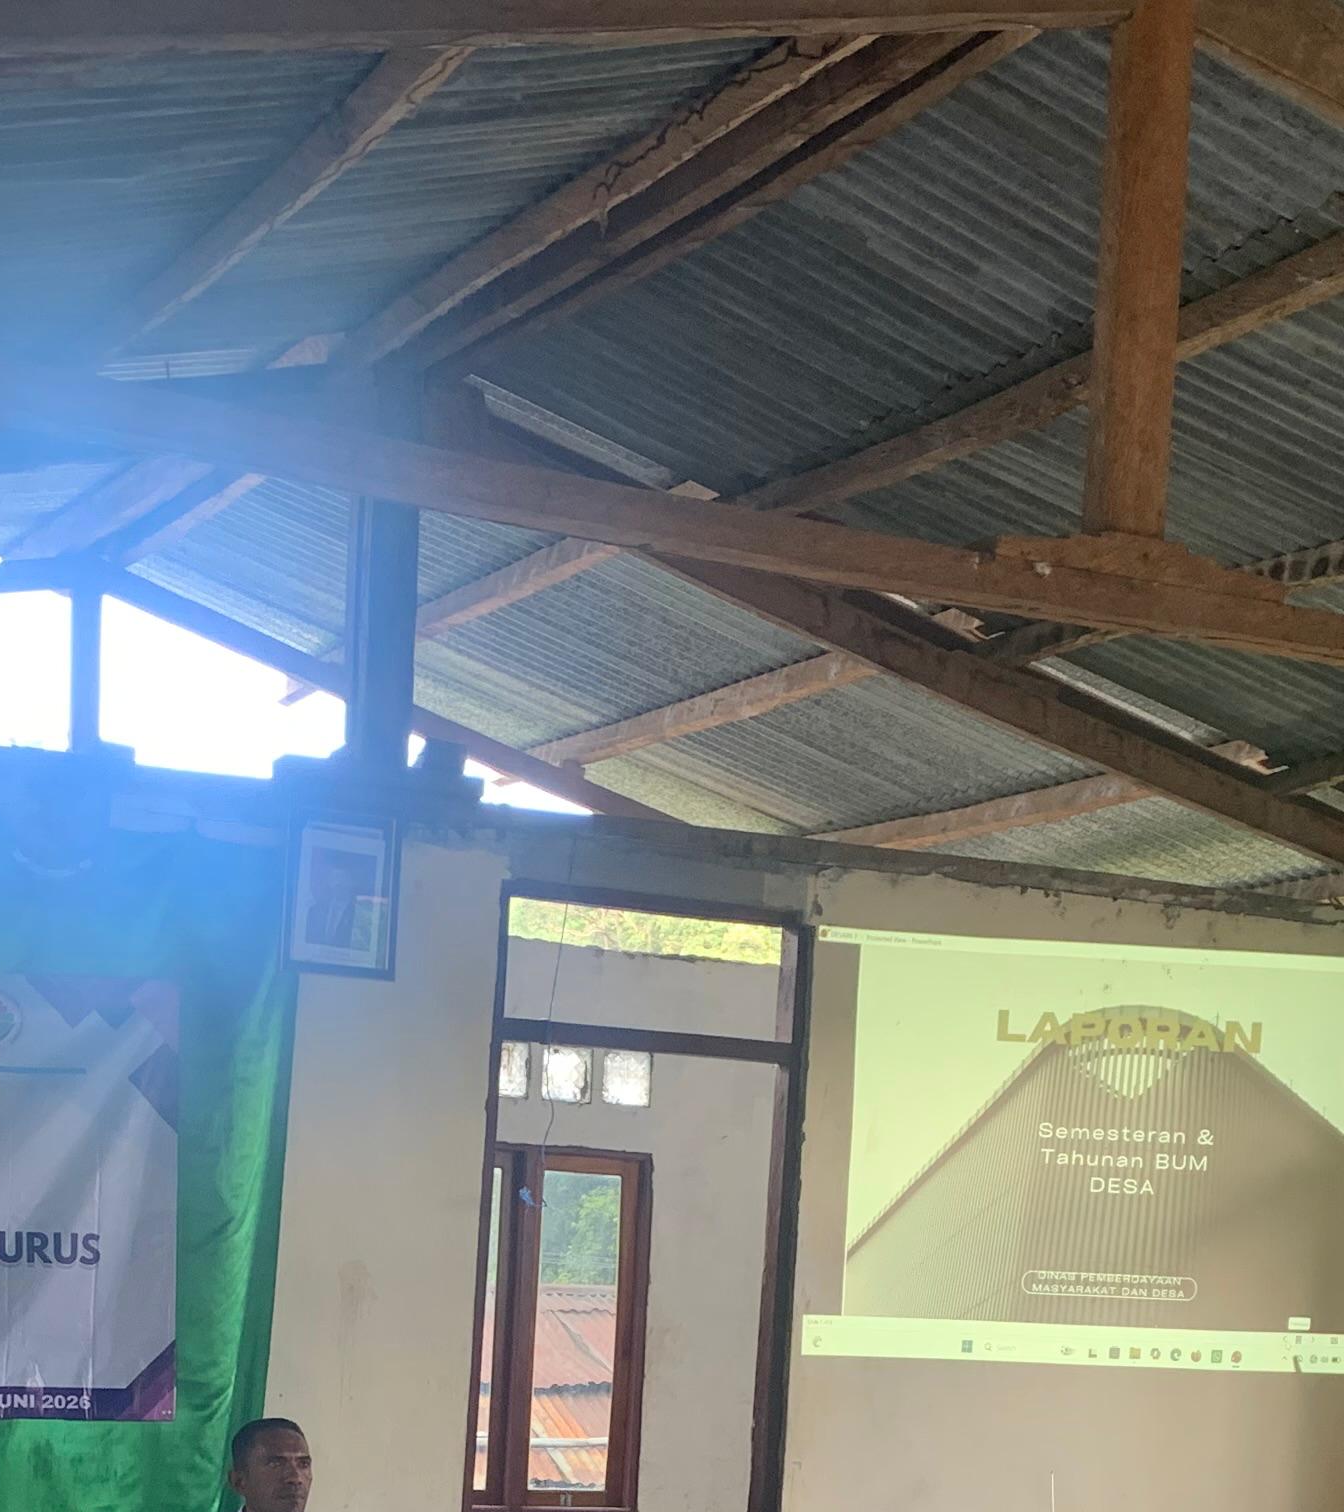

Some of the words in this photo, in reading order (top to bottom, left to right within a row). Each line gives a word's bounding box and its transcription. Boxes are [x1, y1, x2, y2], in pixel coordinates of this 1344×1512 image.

[996, 1009, 1263, 1054] LAPORAN
[1038, 1122, 1185, 1144] Semesteran
[1197, 1129, 1215, 1146] &
[1041, 1148, 1143, 1169] Tahunan
[1156, 1154, 1208, 1171] BUM
[1090, 1177, 1154, 1195] DESA
[1032, 1283, 1117, 1295] MASYARAKAT
[1122, 1287, 1147, 1297] DAN
[1152, 1288, 1185, 1298] DESA
